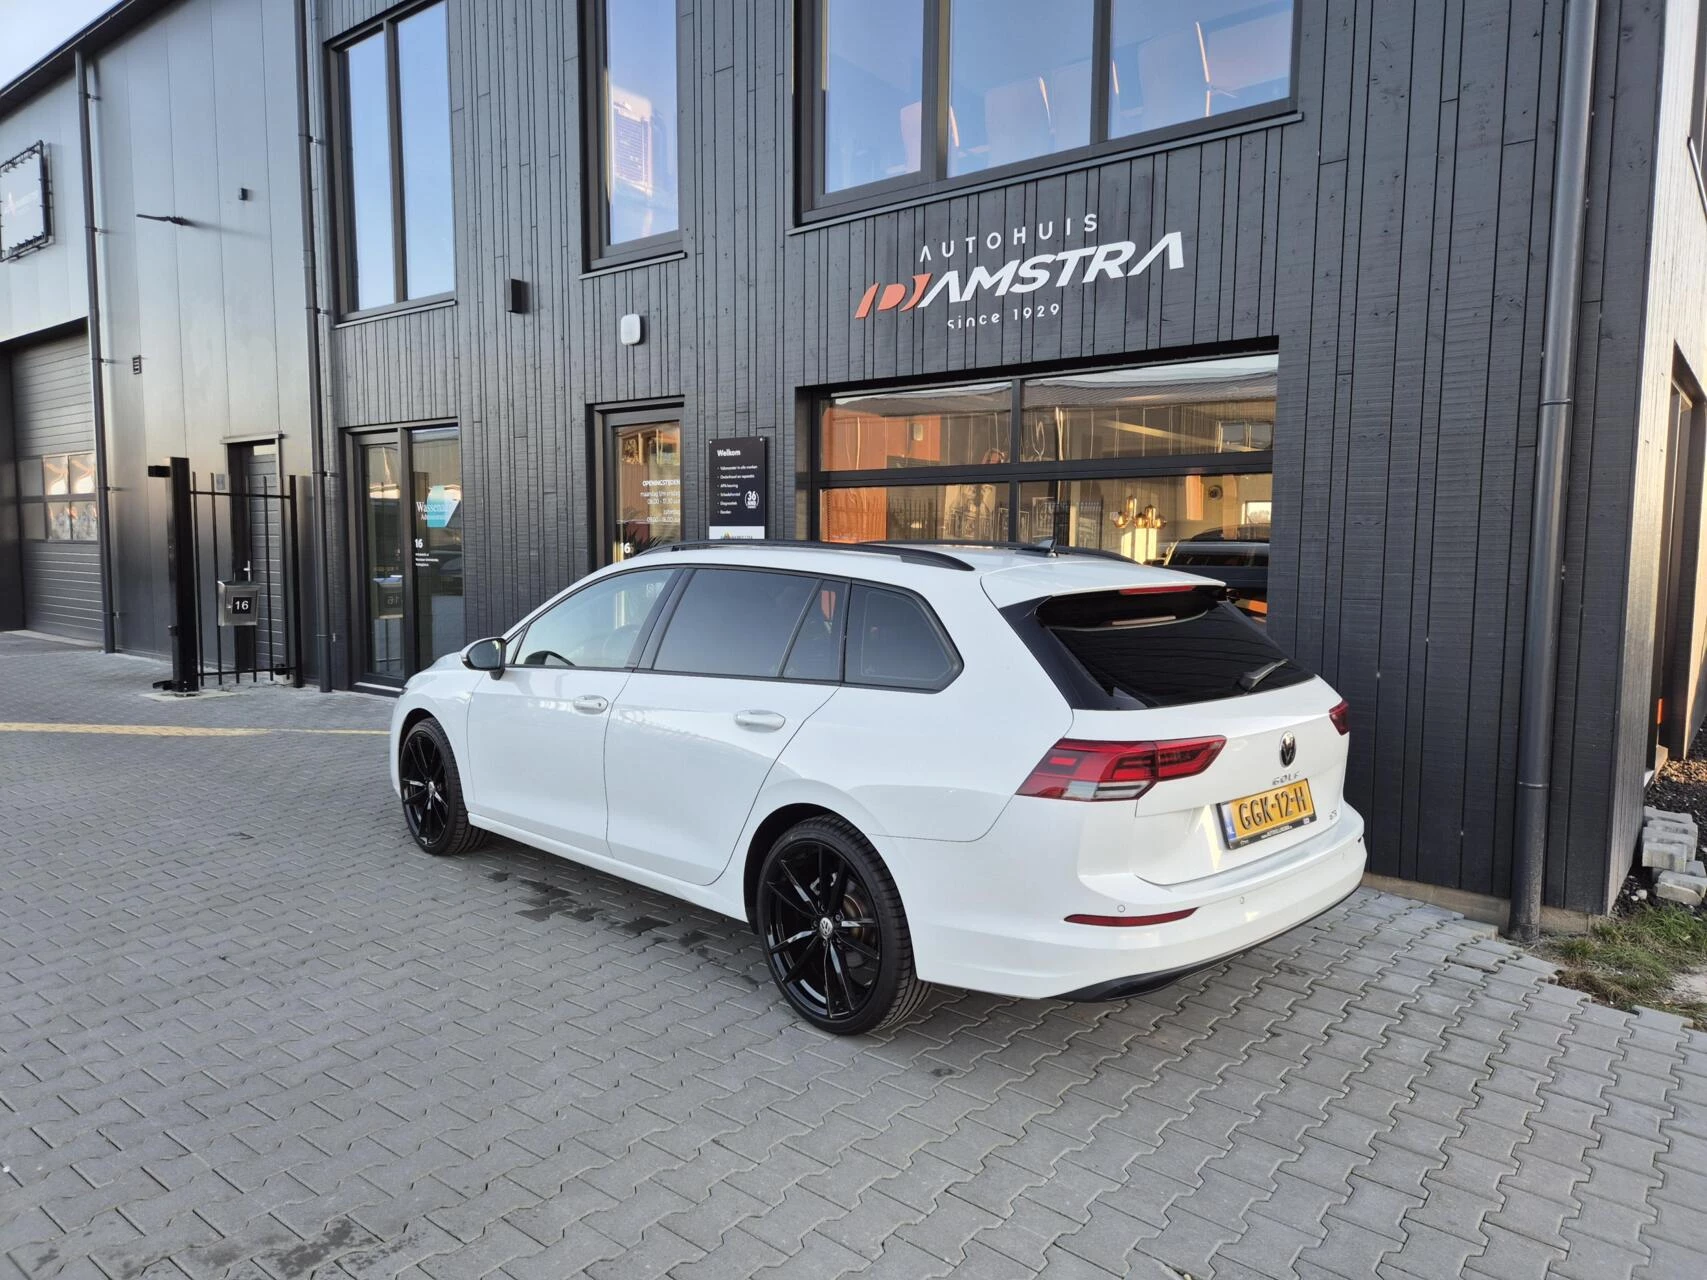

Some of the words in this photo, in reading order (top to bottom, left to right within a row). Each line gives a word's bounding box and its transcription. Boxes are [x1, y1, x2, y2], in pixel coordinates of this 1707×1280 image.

[919, 213, 1099, 263] AUTOHUIS
[947, 311, 1001, 330] since
[1013, 303, 1061, 321] 1929
[717, 449, 741, 457] Welkom
[747, 490, 757, 501] 36
[415, 539, 423, 549] 16
[235, 600, 249, 611] 16
[1272, 771, 1300, 786] GOLF
[1239, 787, 1308, 830] GGK-12-H
